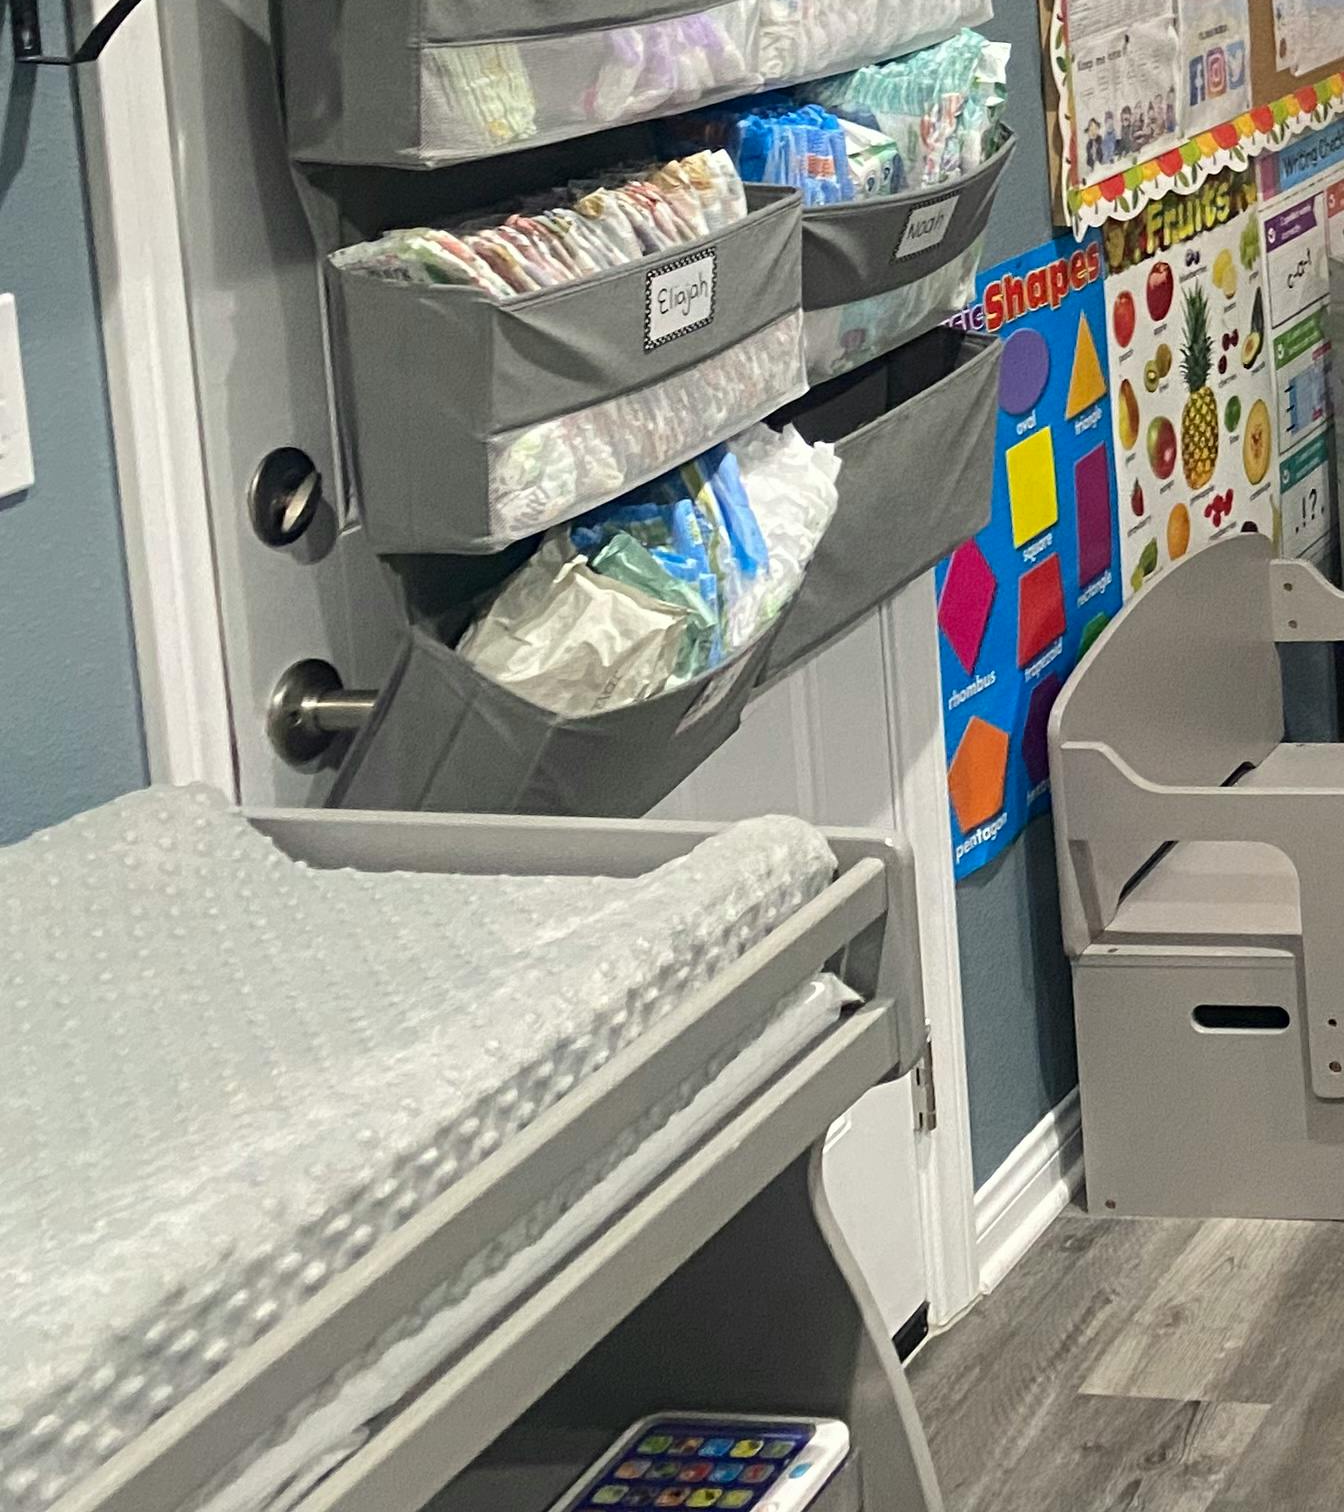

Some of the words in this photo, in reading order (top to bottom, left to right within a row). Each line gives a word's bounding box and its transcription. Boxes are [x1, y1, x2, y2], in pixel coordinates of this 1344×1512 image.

[1282, 148, 1318, 178] Writing
[908, 213, 945, 240] Noah
[1144, 188, 1231, 253] Fruits
[983, 242, 1101, 331] Shapes
[1016, 413, 1036, 436] oval
[1075, 406, 1103, 436] triangle
[1023, 532, 1053, 562] square
[1077, 571, 1113, 607] rectangle
[1025, 640, 1064, 683] trapezoid
[949, 670, 996, 711] rhombus
[956, 813, 1007, 861] pentagon
